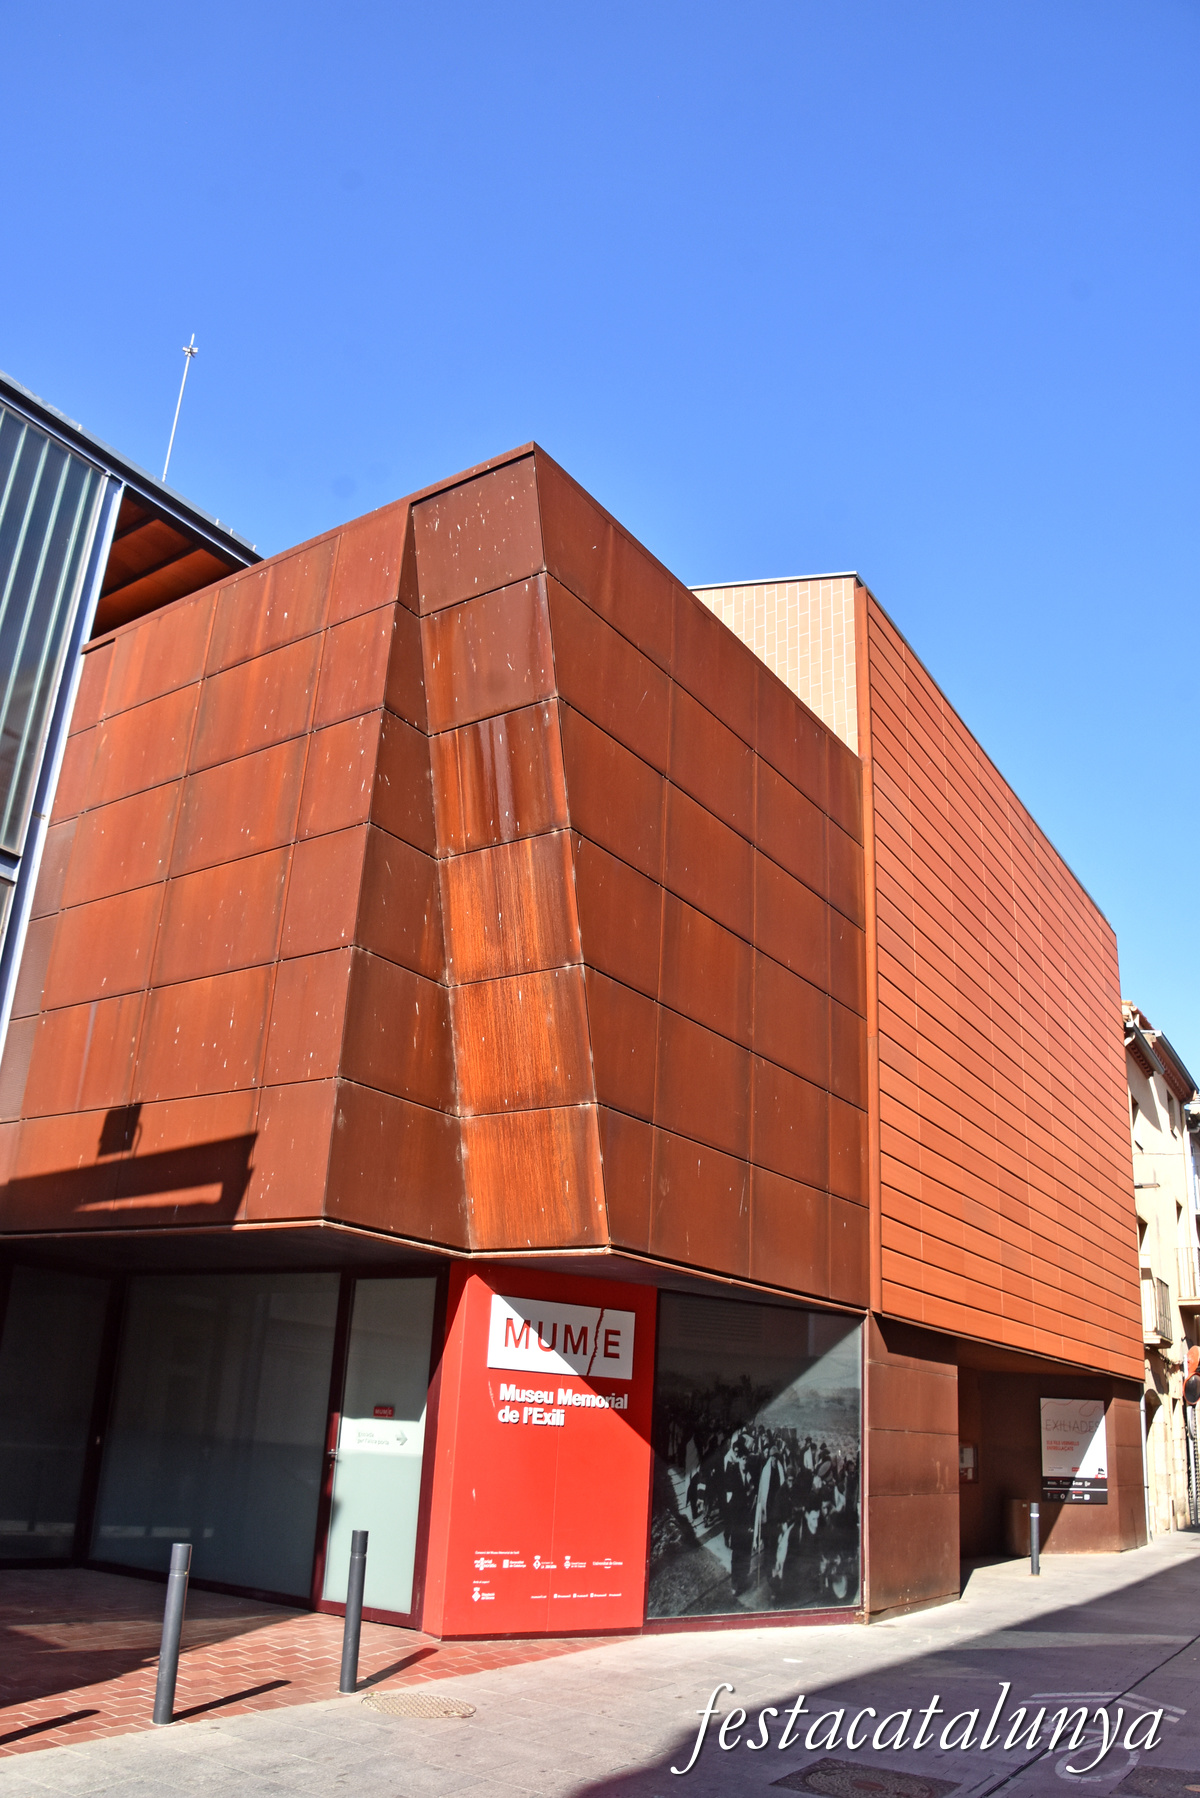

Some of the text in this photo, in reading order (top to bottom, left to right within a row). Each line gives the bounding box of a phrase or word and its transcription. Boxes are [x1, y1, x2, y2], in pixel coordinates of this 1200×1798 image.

[499, 1383, 629, 1410] Museu Memorial
[497, 1405, 520, 1424] de
